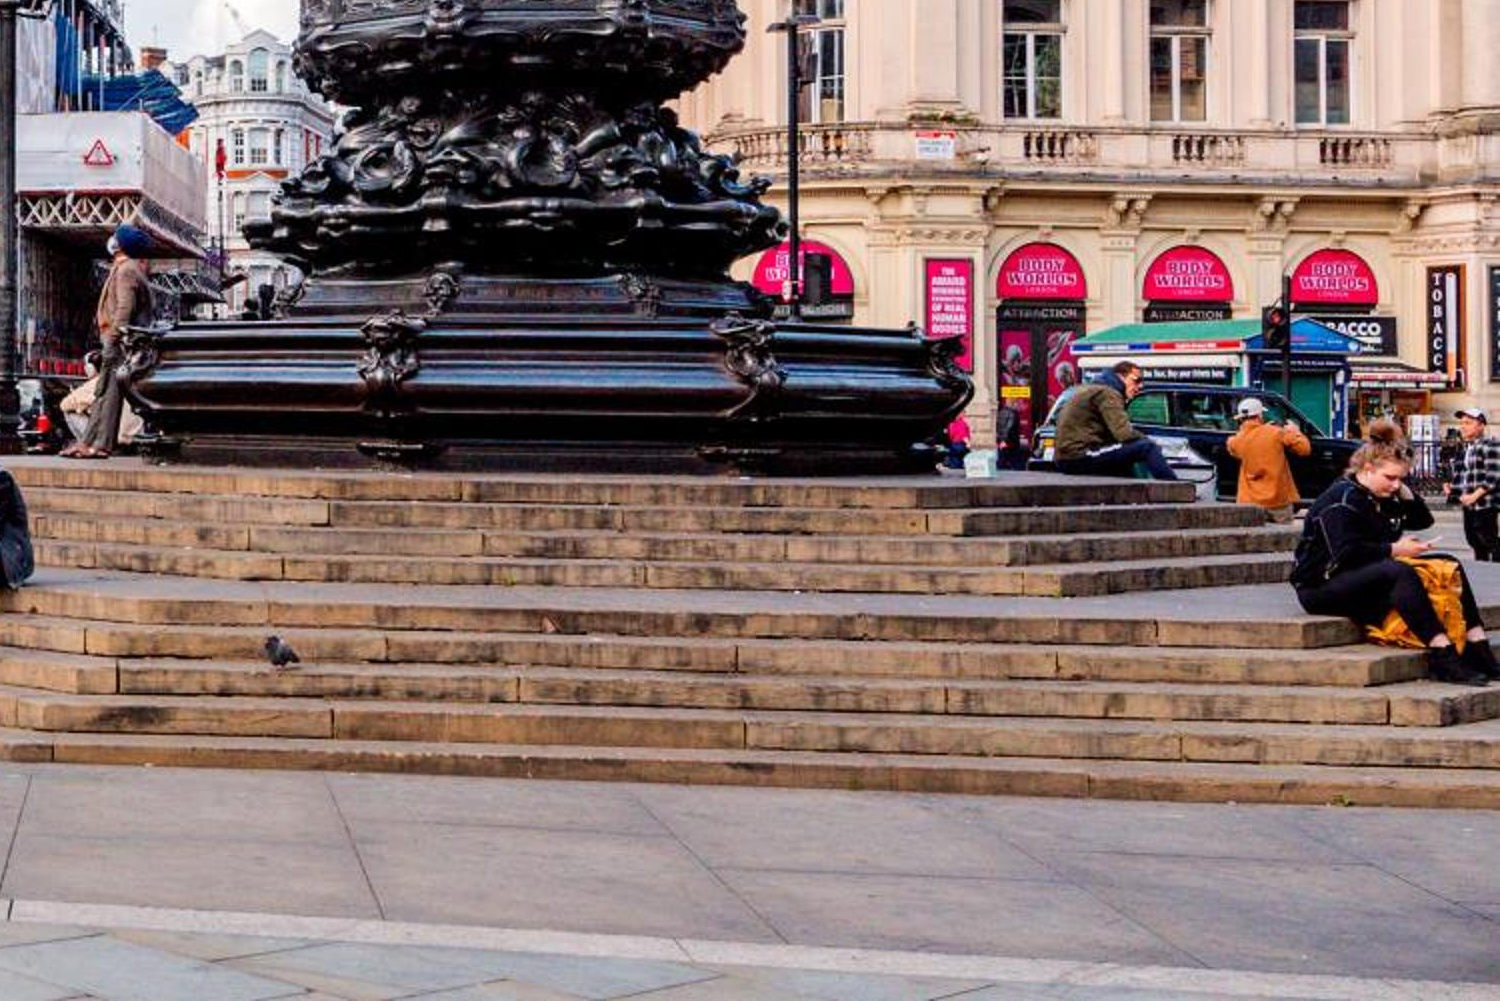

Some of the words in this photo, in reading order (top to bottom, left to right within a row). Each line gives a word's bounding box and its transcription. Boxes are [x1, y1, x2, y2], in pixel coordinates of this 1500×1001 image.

[1019, 258, 1066, 272] BODY
[1166, 261, 1215, 274] BODY
[1312, 263, 1358, 276] BODY
[1006, 272, 1077, 286] WORLDS
[1154, 274, 1225, 288] WORLDS
[1299, 276, 1369, 291] WORLDS
